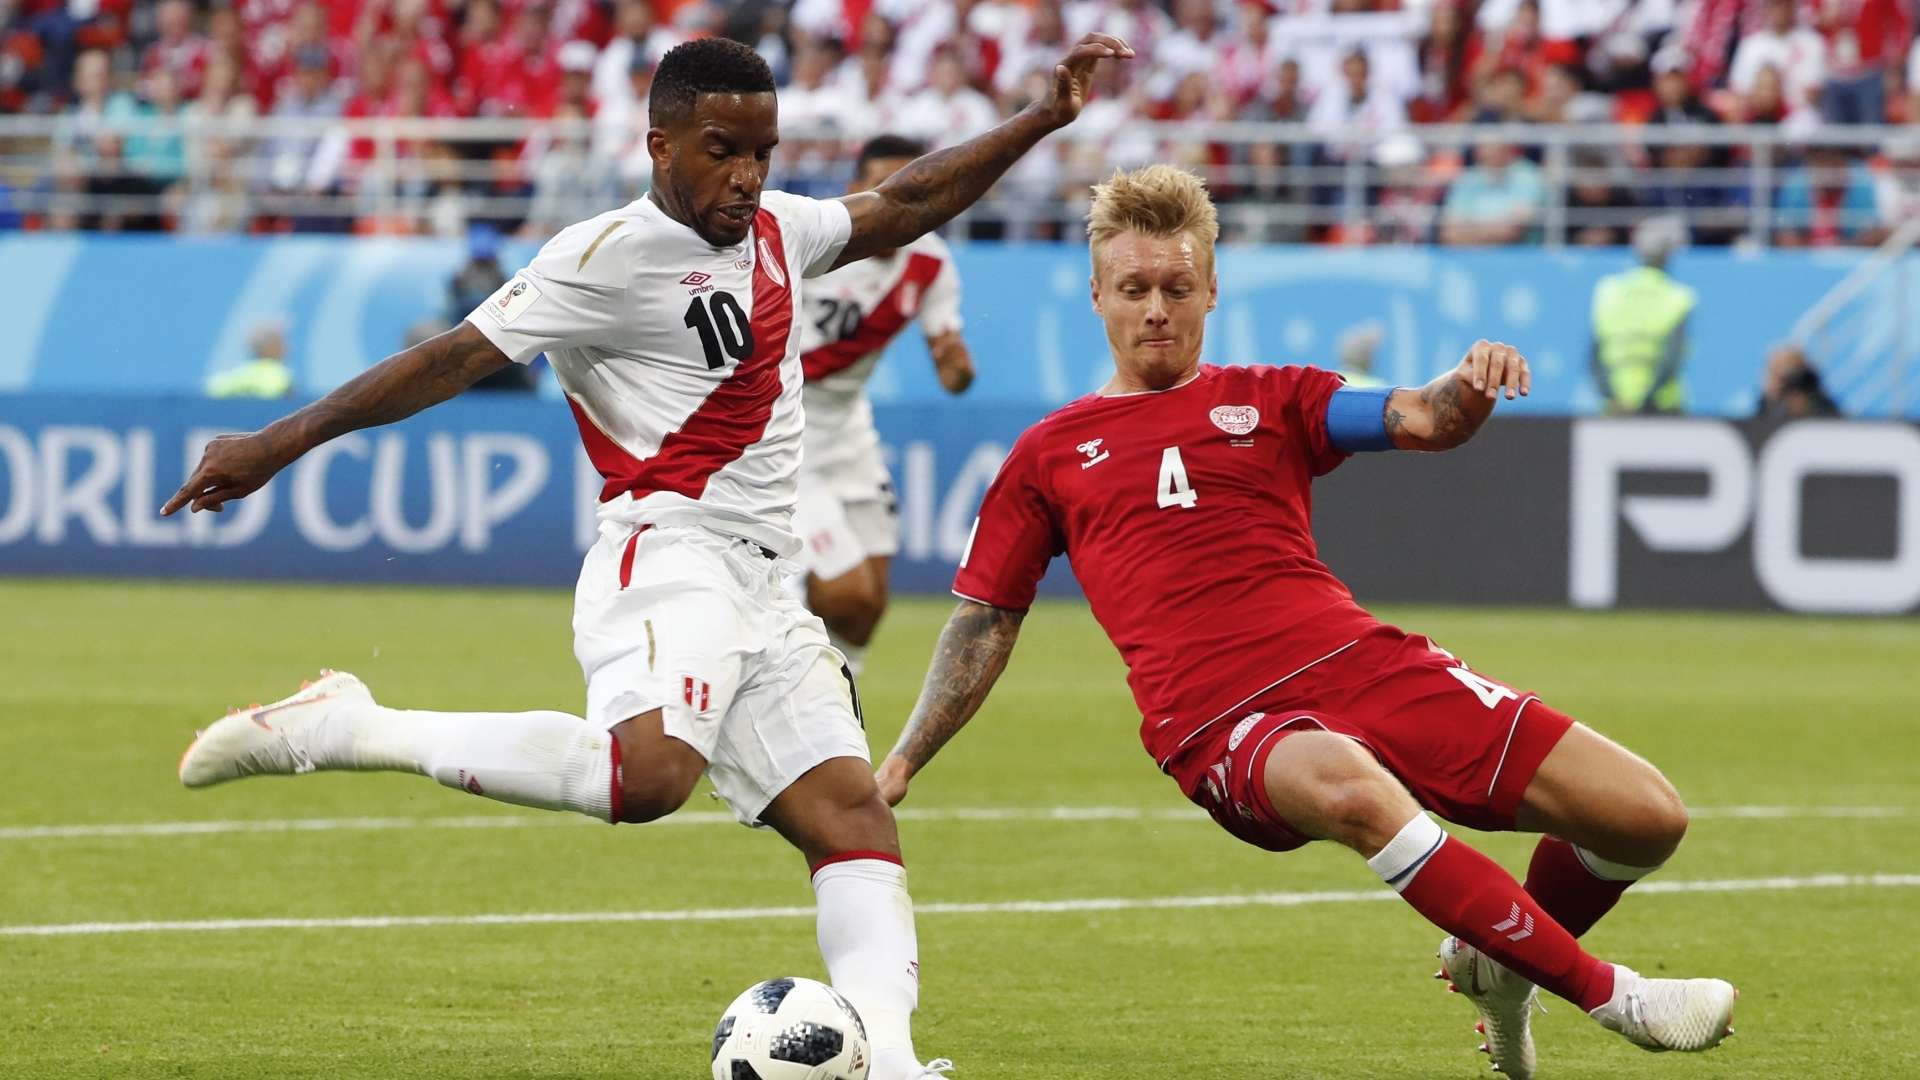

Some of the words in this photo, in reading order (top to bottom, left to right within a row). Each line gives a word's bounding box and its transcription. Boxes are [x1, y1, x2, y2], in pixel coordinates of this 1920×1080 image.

[688, 285, 714, 295] umbro
[815, 299, 862, 340] 20
[684, 291, 754, 369] 10
[290, 428, 550, 554] CUP
[1157, 446, 1198, 509] 4
[1570, 416, 1920, 614] PO
[1446, 666, 1519, 709] 4
